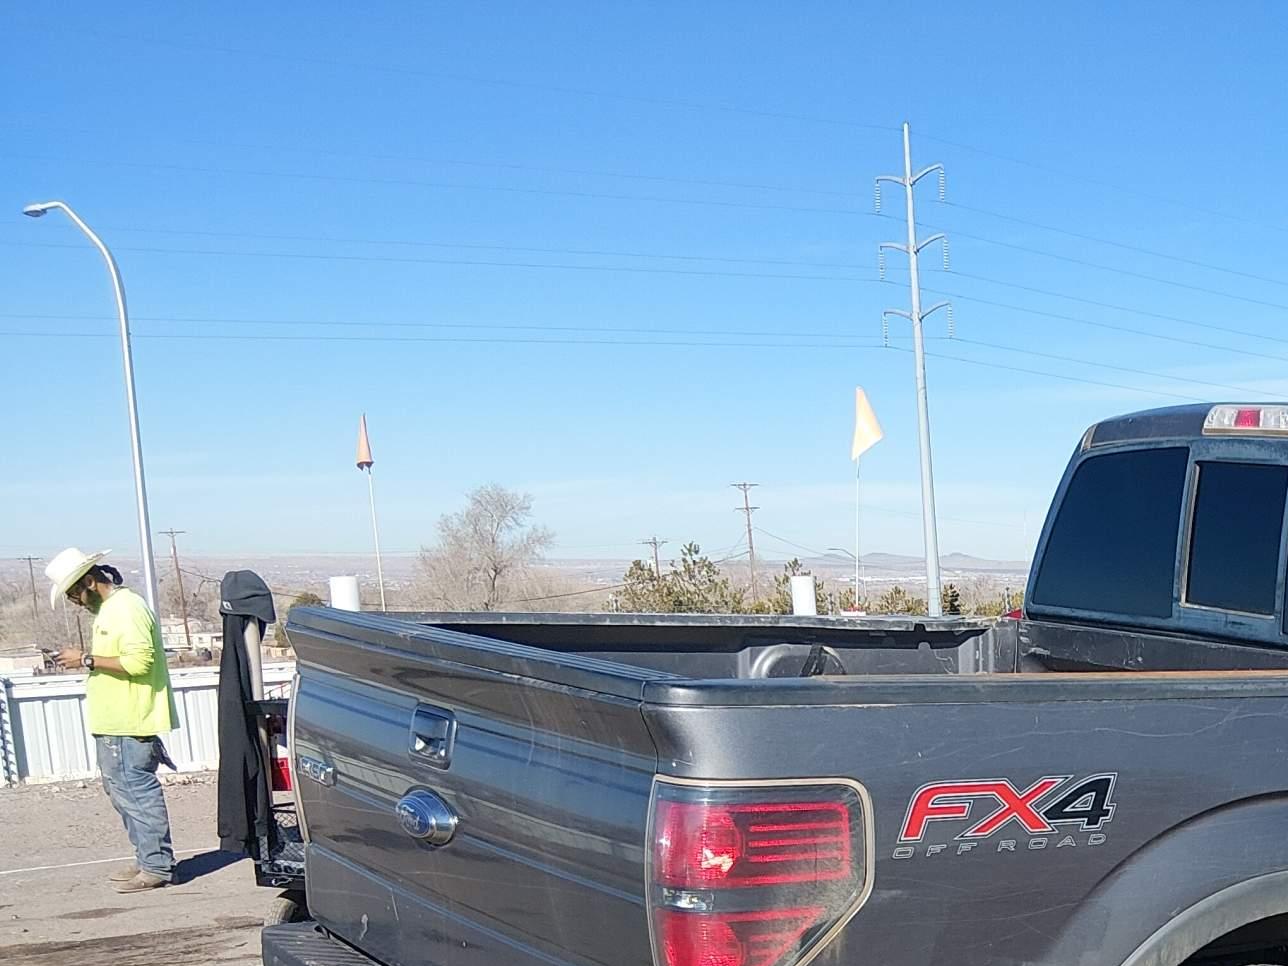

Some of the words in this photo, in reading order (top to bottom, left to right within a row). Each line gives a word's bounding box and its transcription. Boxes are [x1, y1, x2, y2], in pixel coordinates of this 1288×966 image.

[897, 772, 1118, 843] FX4
[892, 842, 977, 859] OFF
[997, 834, 1107, 851] ROAD
